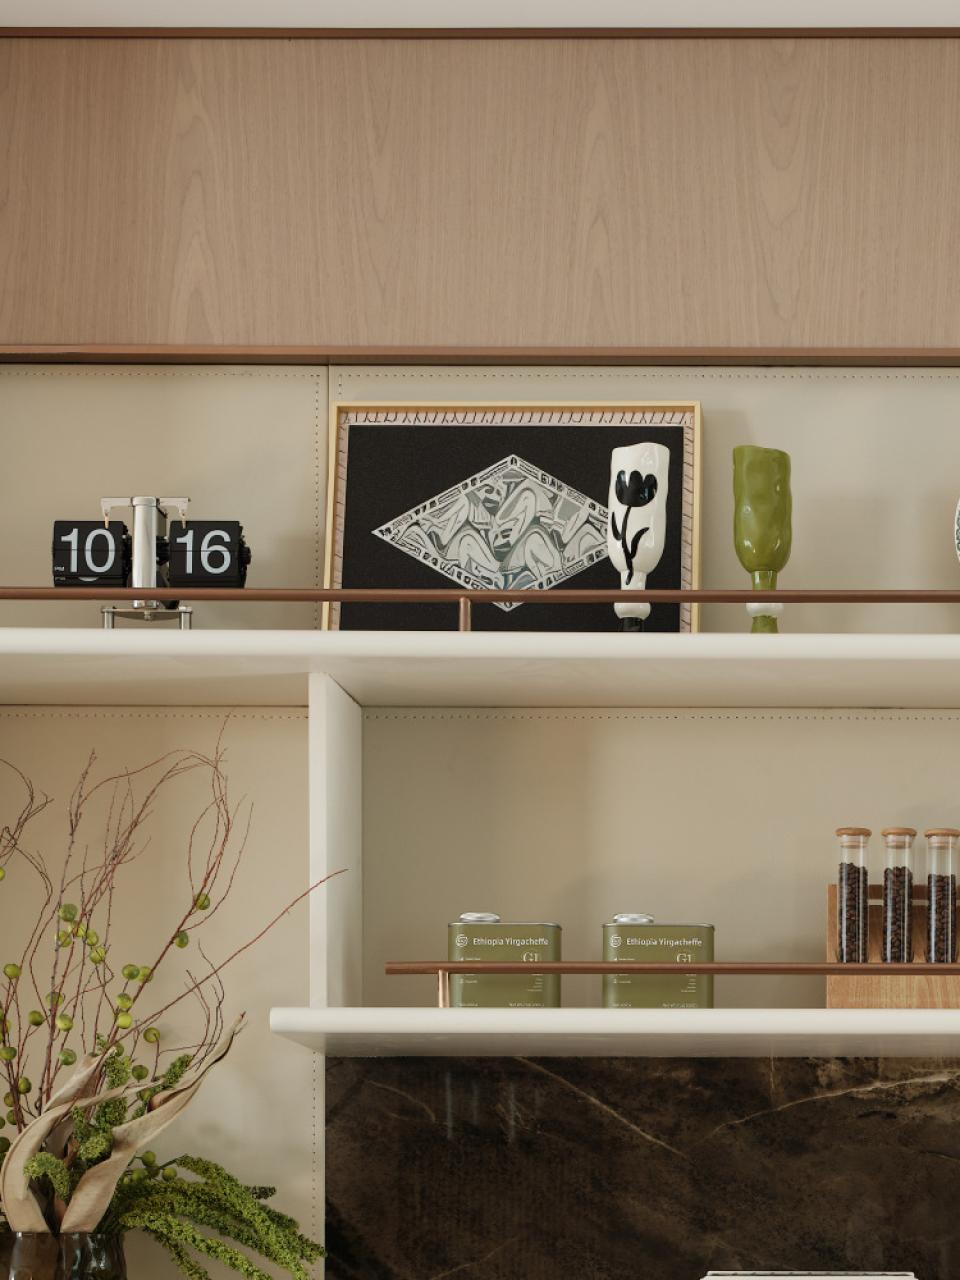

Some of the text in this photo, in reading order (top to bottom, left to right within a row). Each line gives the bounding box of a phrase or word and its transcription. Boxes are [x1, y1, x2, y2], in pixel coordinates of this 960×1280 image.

[60, 528, 231, 574] 10 16
[473, 937, 549, 947] Ethiopia Yirgacheffe
[626, 937, 702, 947] Ethiopia Yirgacheffe
